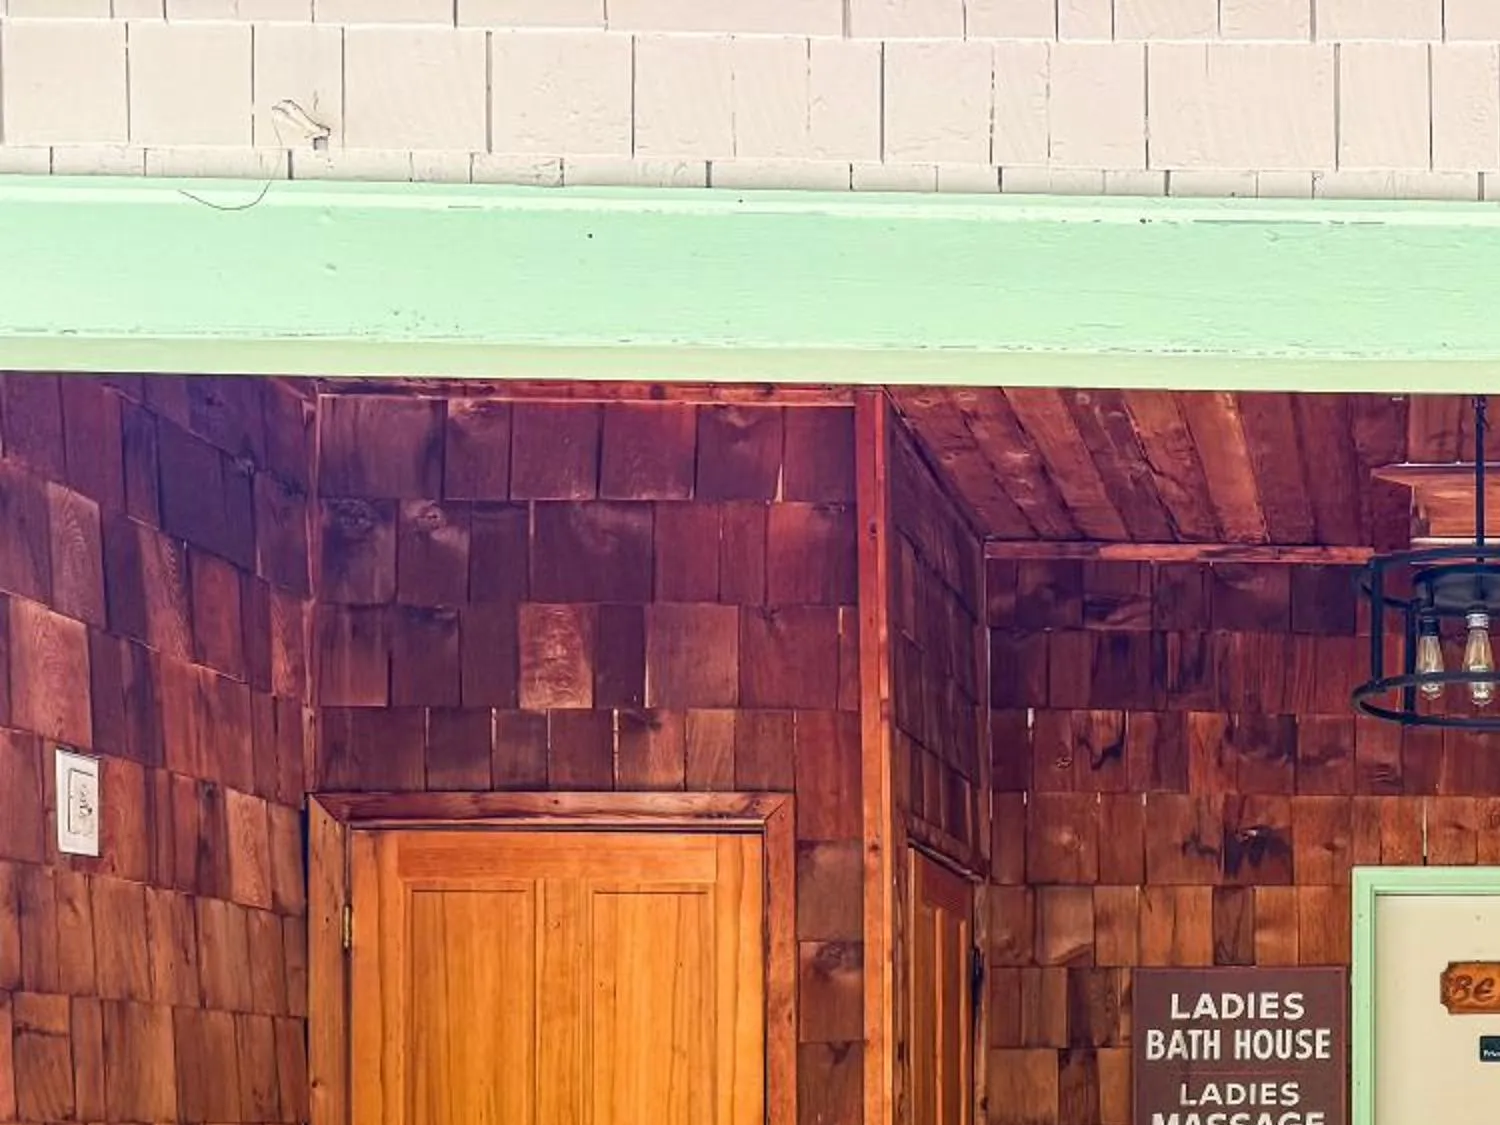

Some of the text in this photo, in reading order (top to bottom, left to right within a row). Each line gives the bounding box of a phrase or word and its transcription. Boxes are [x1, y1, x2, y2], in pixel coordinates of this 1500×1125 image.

[1171, 992, 1305, 1020] LADIES
[1146, 1028, 1331, 1061] BATH HOUSE
[1180, 1083, 1300, 1106] LADIES
